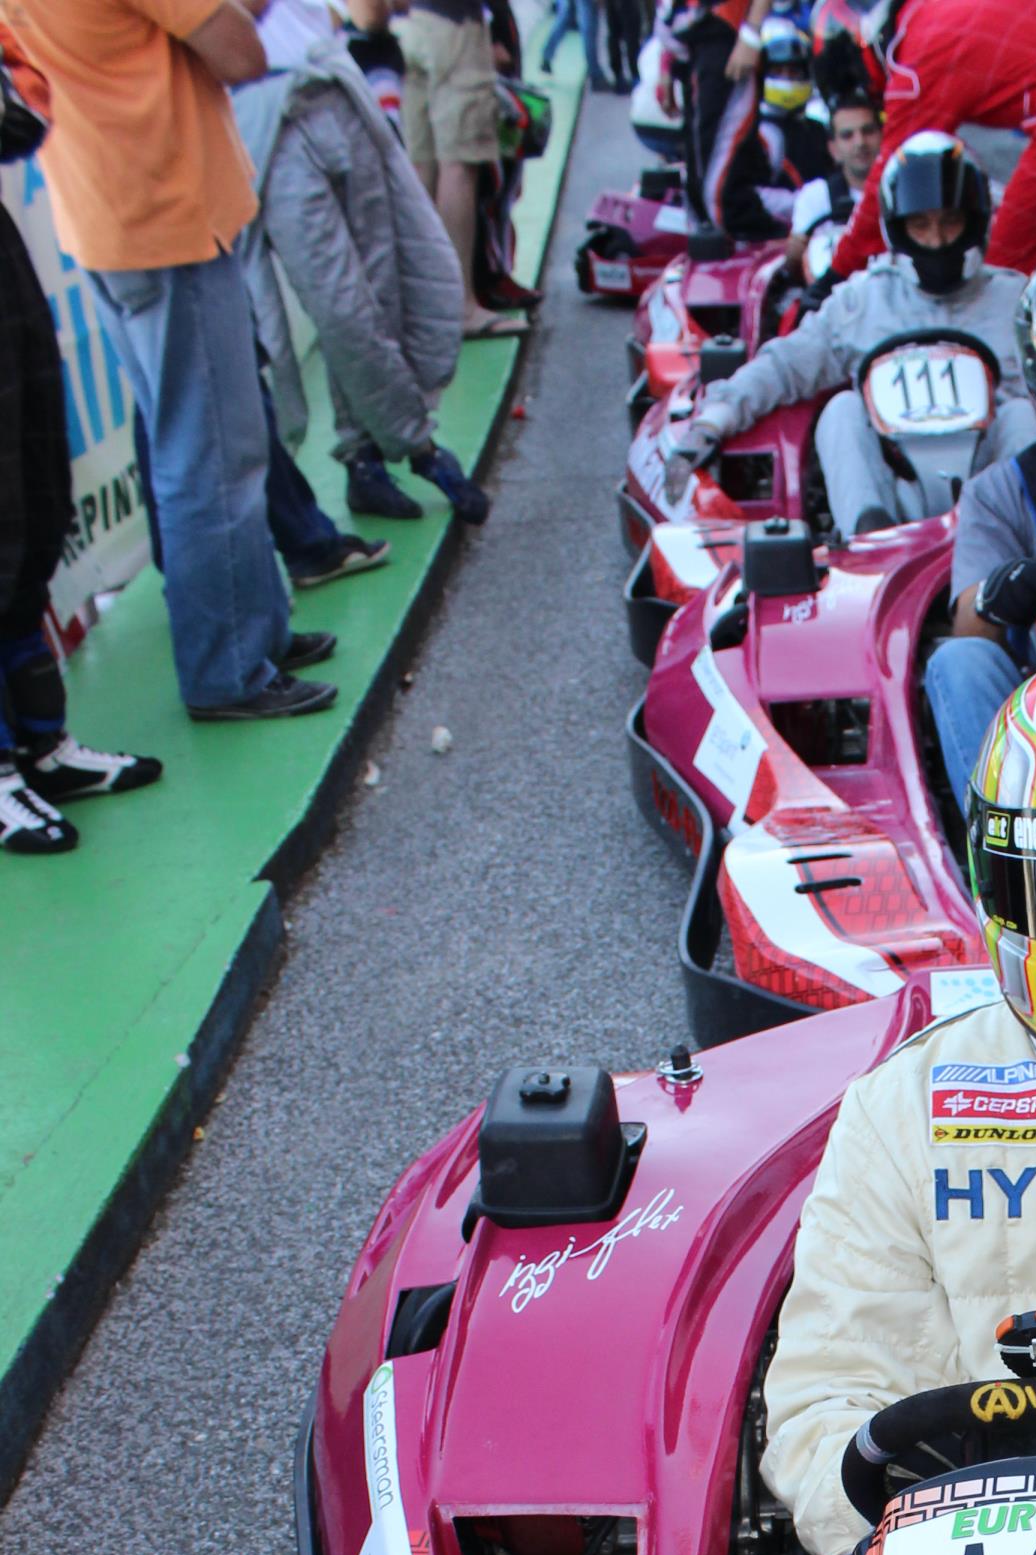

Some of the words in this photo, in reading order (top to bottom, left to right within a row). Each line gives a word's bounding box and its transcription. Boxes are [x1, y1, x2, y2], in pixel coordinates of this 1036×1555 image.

[891, 360, 960, 410] 111
[987, 814, 1008, 838] ekt
[370, 1390, 395, 1511] Steersman
